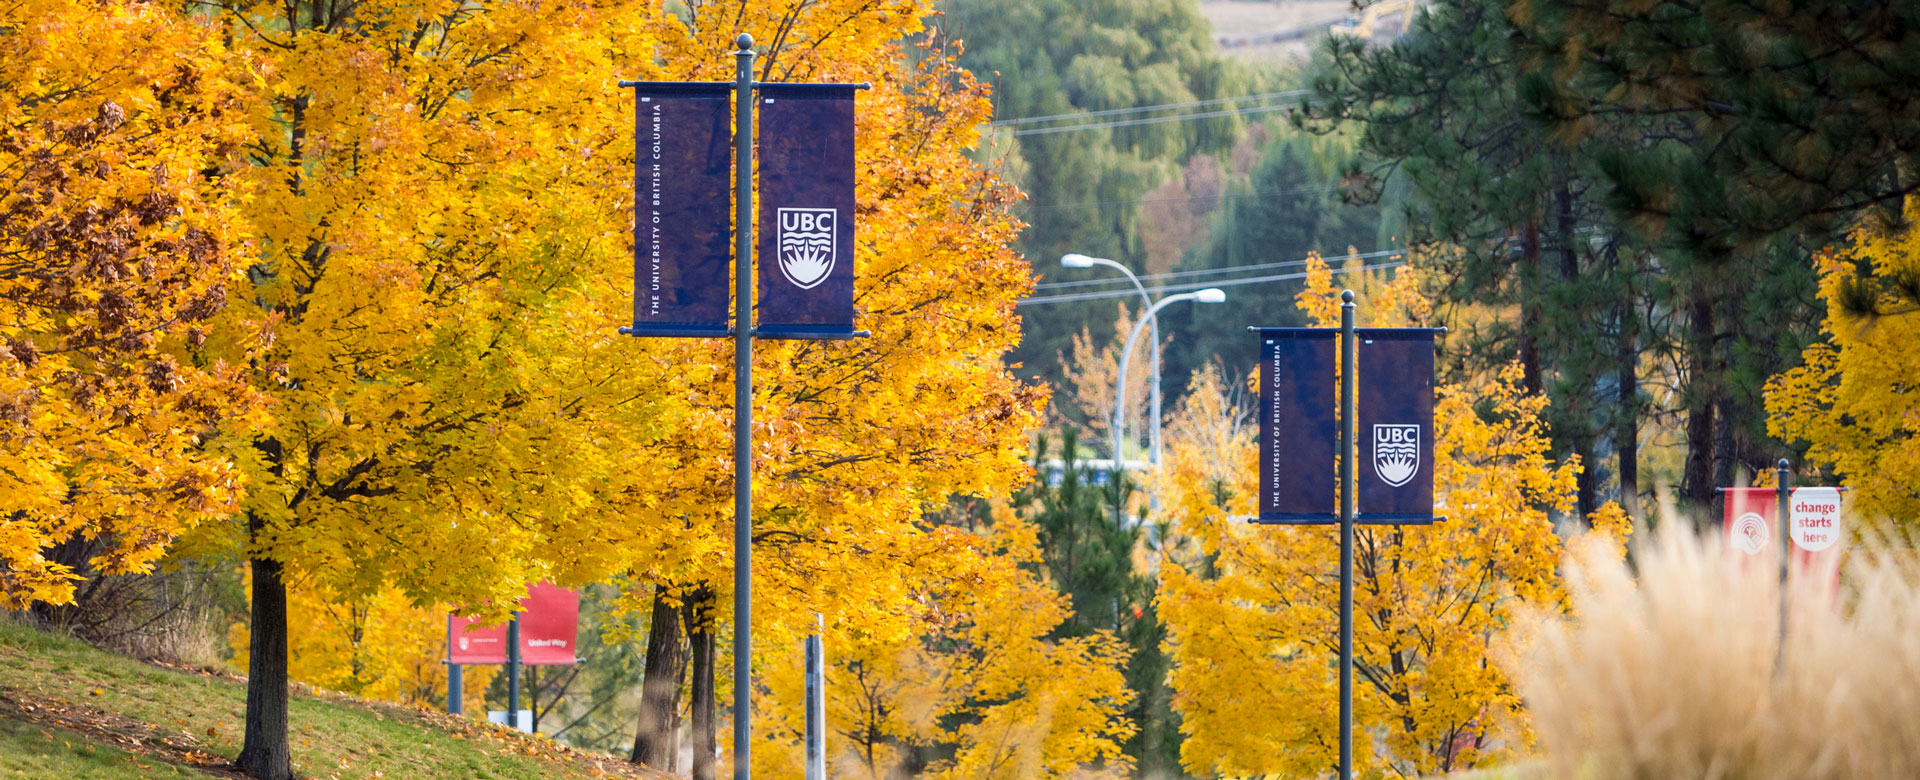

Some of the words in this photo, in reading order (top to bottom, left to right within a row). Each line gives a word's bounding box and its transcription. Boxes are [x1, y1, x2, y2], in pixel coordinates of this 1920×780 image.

[652, 104, 661, 160] COLUMBIA
[652, 163, 661, 206] BRITISH
[652, 210, 661, 223] OF
[782, 212, 832, 232] UBC
[651, 226, 660, 291] UNIVERSITY
[651, 295, 660, 316] THE
[1273, 344, 1281, 388] COLUMBIA
[1273, 426, 1280, 437] OF
[1377, 427, 1416, 443] UBC
[1795, 501, 1836, 515] change
[1798, 517, 1832, 528] starts
[1803, 531, 1828, 543] here
